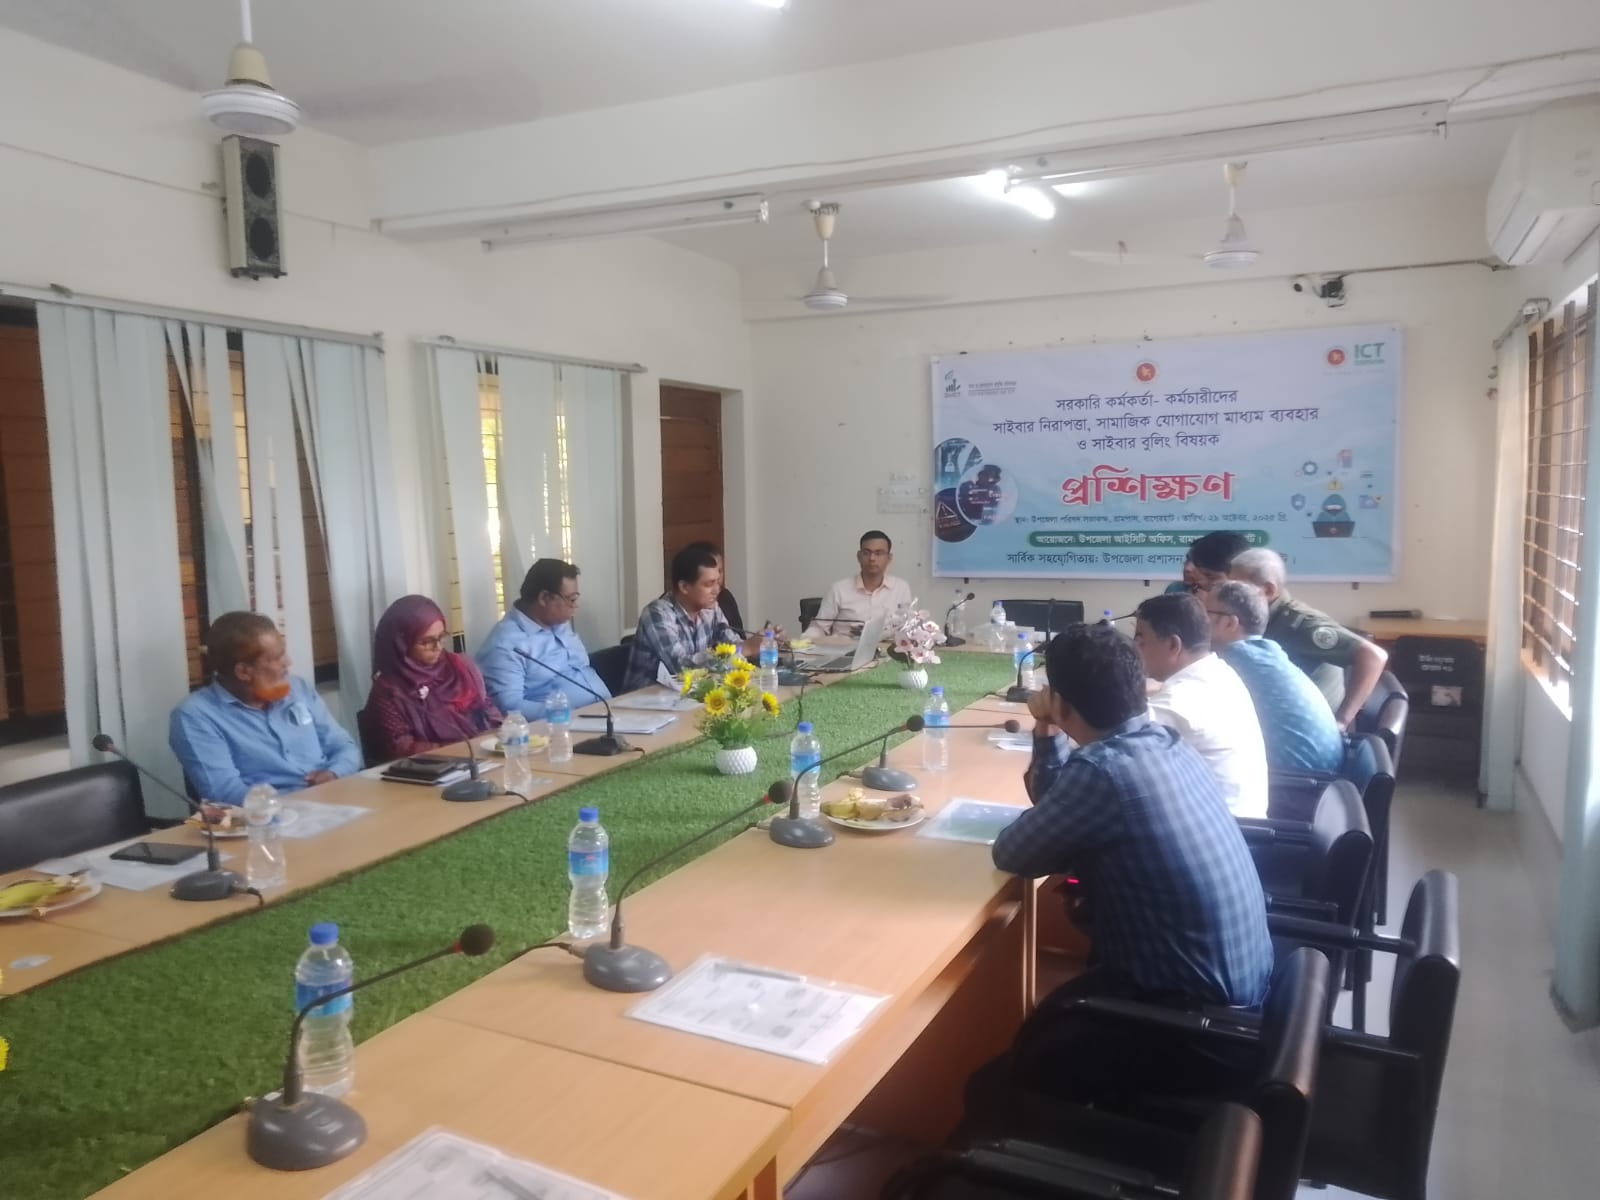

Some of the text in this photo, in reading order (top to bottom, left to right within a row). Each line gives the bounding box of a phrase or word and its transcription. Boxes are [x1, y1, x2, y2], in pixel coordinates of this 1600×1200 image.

[1354, 342, 1385, 359] ICT
[1055, 393, 1101, 411] সরকারি
[1165, 387, 1239, 405] কর্মচারীদের
[993, 419, 1035, 435] সাইবার
[1096, 412, 1151, 430] সামাজিক
[1155, 411, 1219, 428] যোগাযোগ
[1223, 410, 1265, 424] মাধ্যম
[1269, 407, 1320, 423] ব্যবহার
[1077, 431, 1221, 452] ও সাইবার বুলিং বিষয়ক
[1061, 464, 1236, 506] প্রশিক্ষণ
[1078, 533, 1112, 544] উপজেলা
[1113, 532, 1147, 545] আইসিটি
[1007, 551, 1035, 564] সার্বিক
[1103, 551, 1144, 565] উপজেলা
